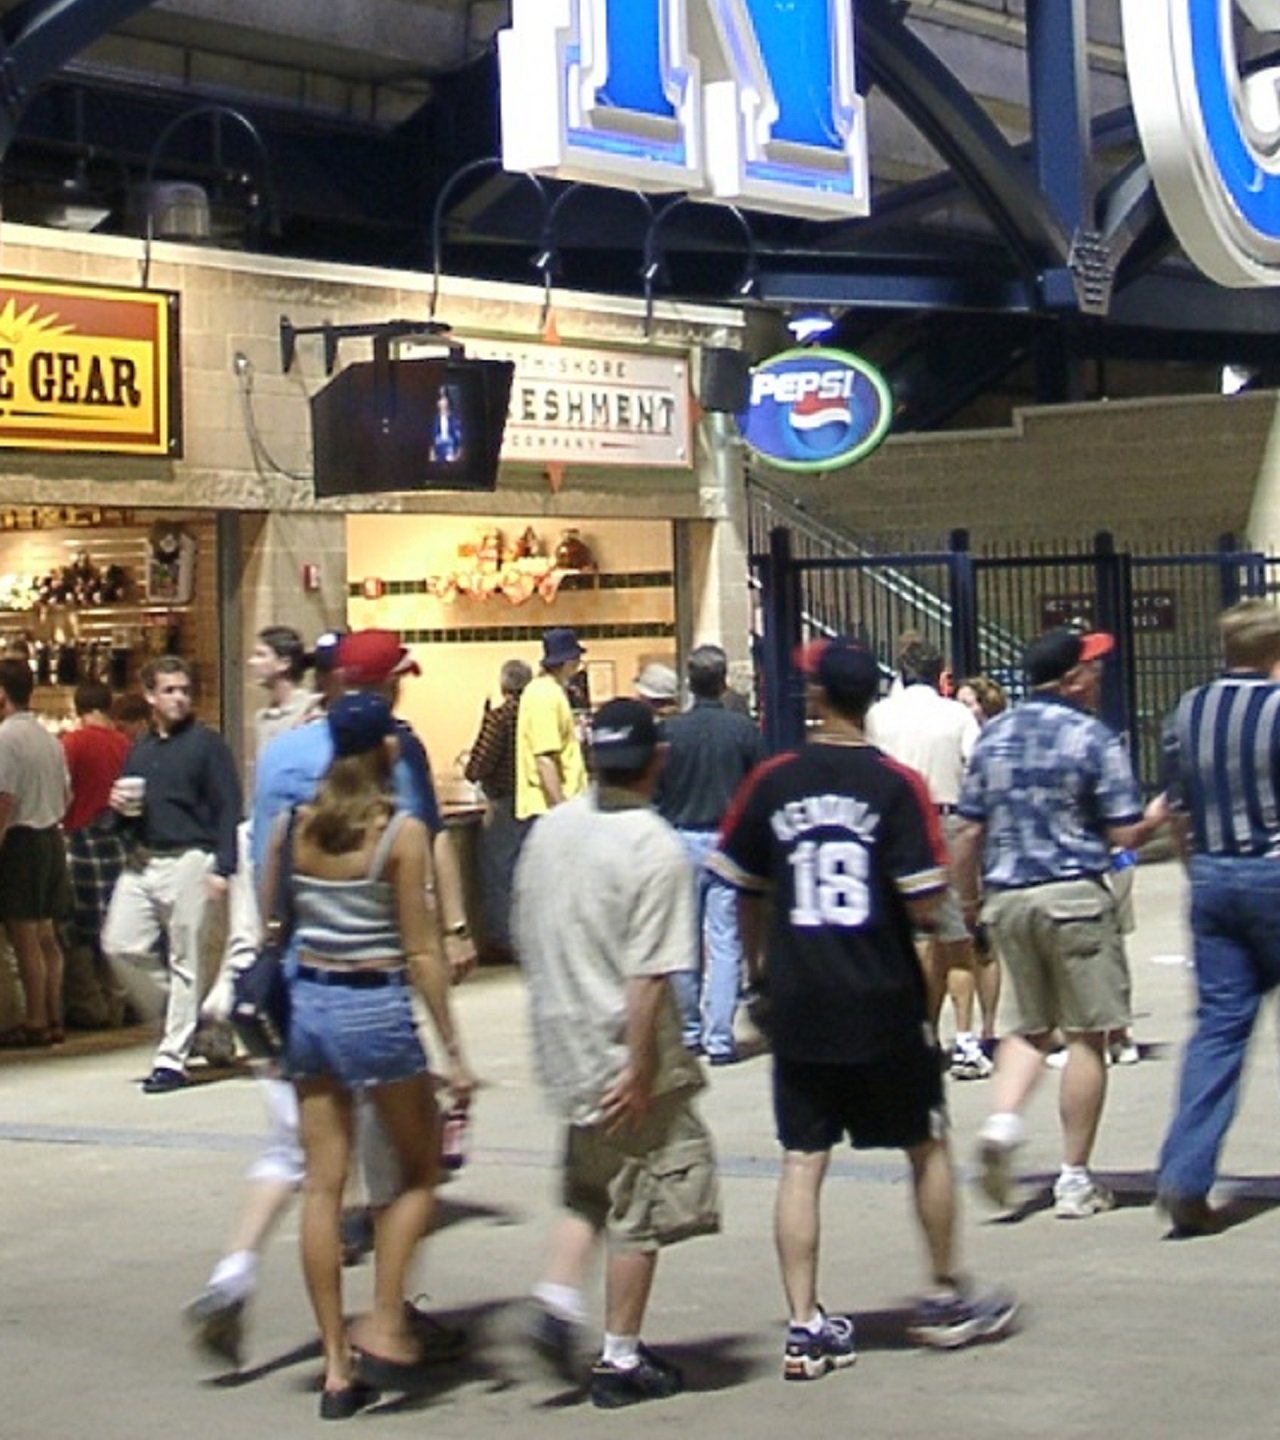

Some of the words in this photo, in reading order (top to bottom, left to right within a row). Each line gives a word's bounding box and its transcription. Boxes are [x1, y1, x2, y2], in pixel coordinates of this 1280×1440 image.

[28, 350, 142, 408] GEAR
[750, 368, 855, 404] PEPSI
[510, 387, 676, 435] ESHMENT
[786, 839, 870, 927] 18
